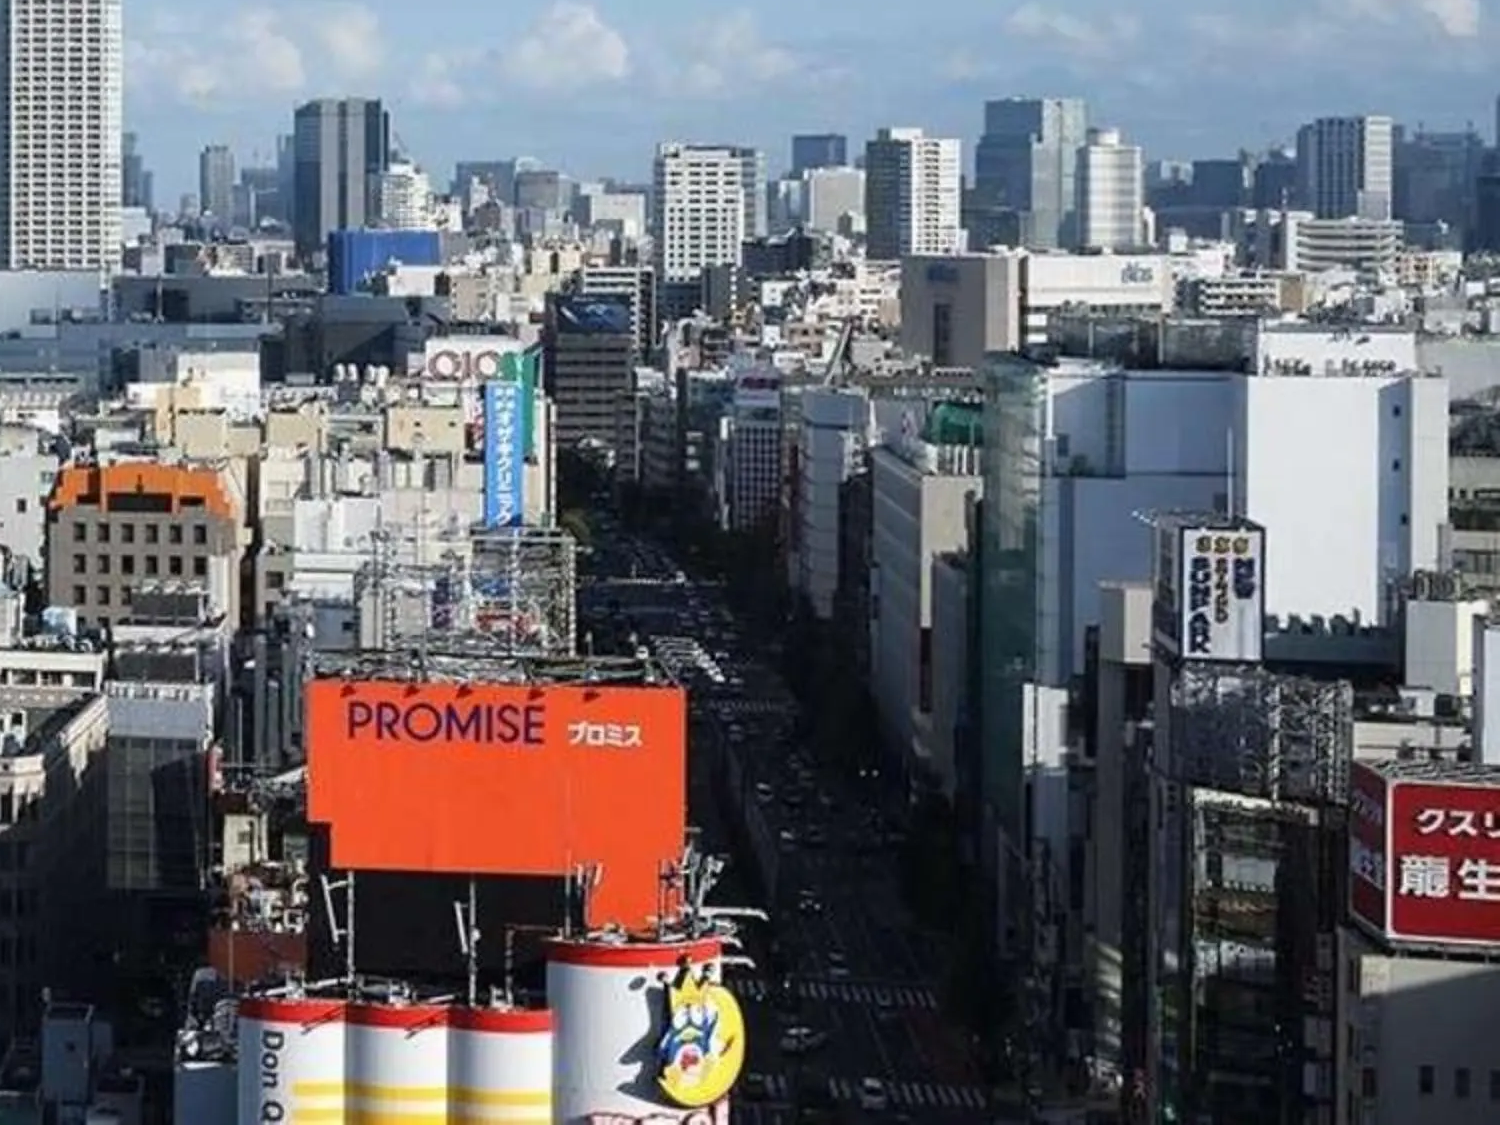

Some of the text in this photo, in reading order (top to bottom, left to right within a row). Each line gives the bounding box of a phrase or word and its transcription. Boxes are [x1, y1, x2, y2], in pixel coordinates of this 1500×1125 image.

[347, 701, 643, 747] PROMISE プロミス
[261, 1029, 285, 1088] Don
